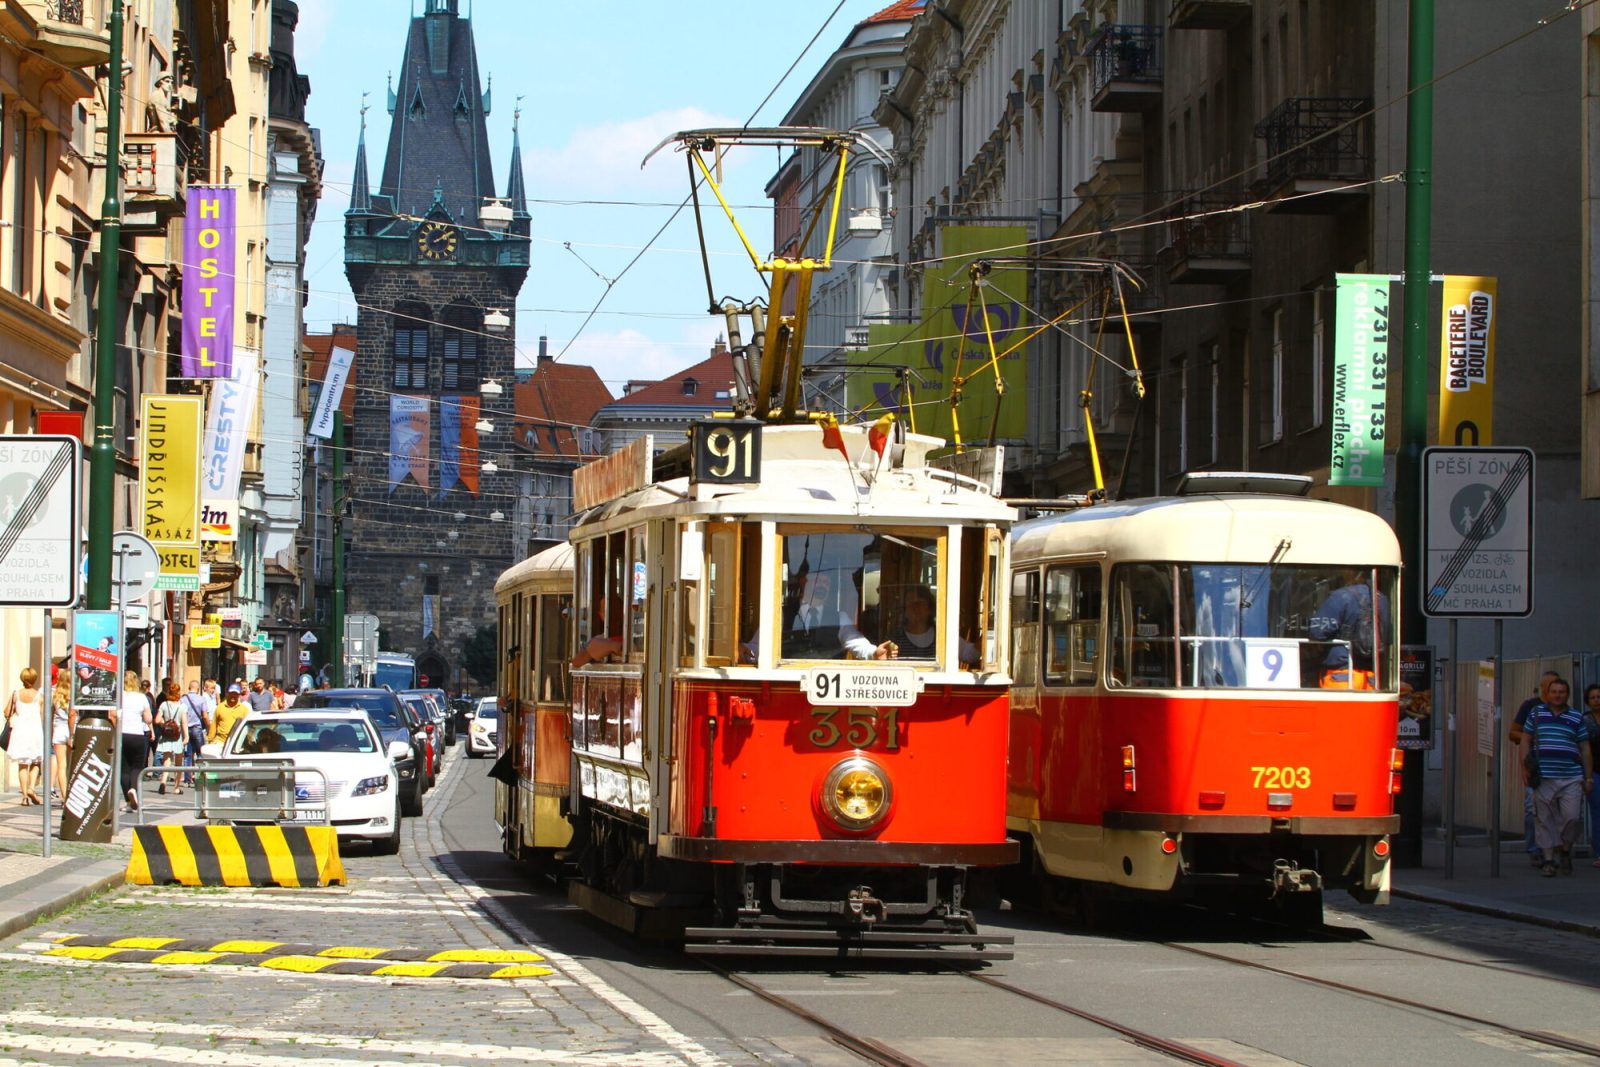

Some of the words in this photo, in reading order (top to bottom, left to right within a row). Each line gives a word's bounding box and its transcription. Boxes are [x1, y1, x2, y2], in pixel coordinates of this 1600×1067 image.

[198, 199, 221, 367] HOSTEL
[1373, 305, 1388, 343] 731
[1467, 295, 1489, 378] BOULEVARD
[1449, 309, 1468, 389] BAGETERIE
[1371, 352, 1387, 390] 331
[318, 373, 340, 429] Hypocentrum
[1332, 363, 1351, 469] www.erflex.cz
[1370, 402, 1385, 441] 133
[0, 446, 14, 463] ŠÍ
[22, 446, 55, 463] ZÓN
[707, 427, 752, 477] 91
[1349, 399, 1371, 479] plocha
[146, 403, 167, 526] JINDŘIŠSKÁ
[1435, 457, 1471, 475] PĚŠÍ
[1479, 457, 1520, 475] ZÓN
[201, 506, 228, 524] dm
[146, 528, 192, 539] PASÁŽ
[4, 559, 49, 568] VOZIDLA
[159, 553, 196, 568] STEL
[1462, 569, 1507, 579] VOZIDLA
[6, 588, 44, 598] PRAHA
[1443, 597, 1459, 608] MČ
[1464, 599, 1502, 608] PRAHA
[1507, 599, 1512, 608] 1
[1454, 584, 1521, 594] SOUHLASEM
[1262, 648, 1284, 682] 9
[815, 673, 841, 698] 91
[852, 675, 899, 685] VOZOVNA
[845, 687, 908, 699] STŘEŠOVICE
[809, 706, 899, 748] 351
[65, 752, 112, 819] DUPLEX
[1251, 766, 1312, 789] 7203
